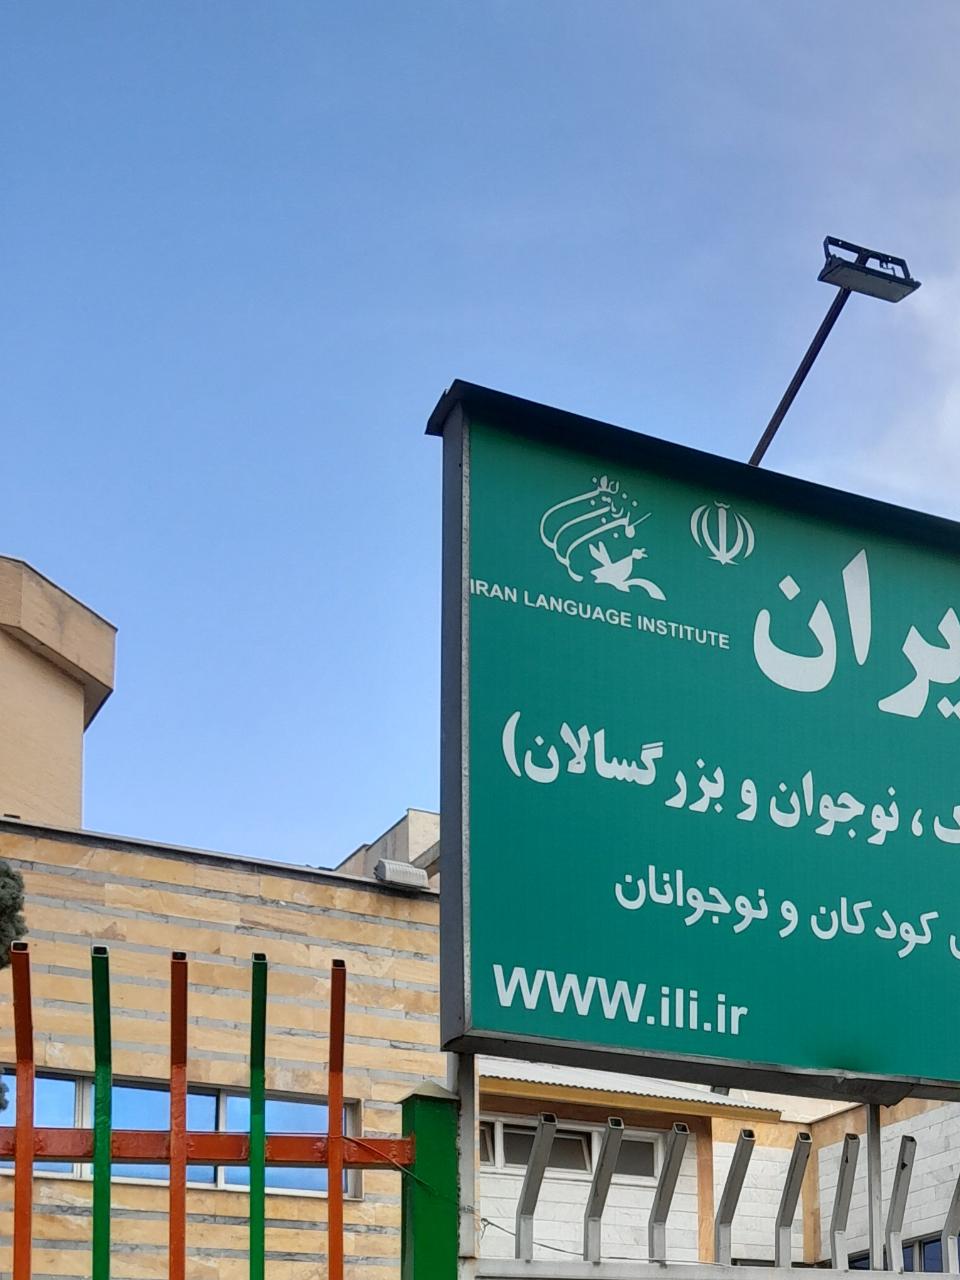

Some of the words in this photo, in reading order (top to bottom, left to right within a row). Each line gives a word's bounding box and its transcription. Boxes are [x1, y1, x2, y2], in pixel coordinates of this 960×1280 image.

[470, 578, 518, 603] IRAN
[523, 590, 632, 628] LANGUAGE
[637, 615, 731, 649] INSTITUTE
[736, 778, 759, 821] و
[769, 771, 900, 846] نوجوان
[614, 865, 769, 933] نوجوانان
[779, 900, 799, 938] و
[810, 896, 940, 960] کودکان
